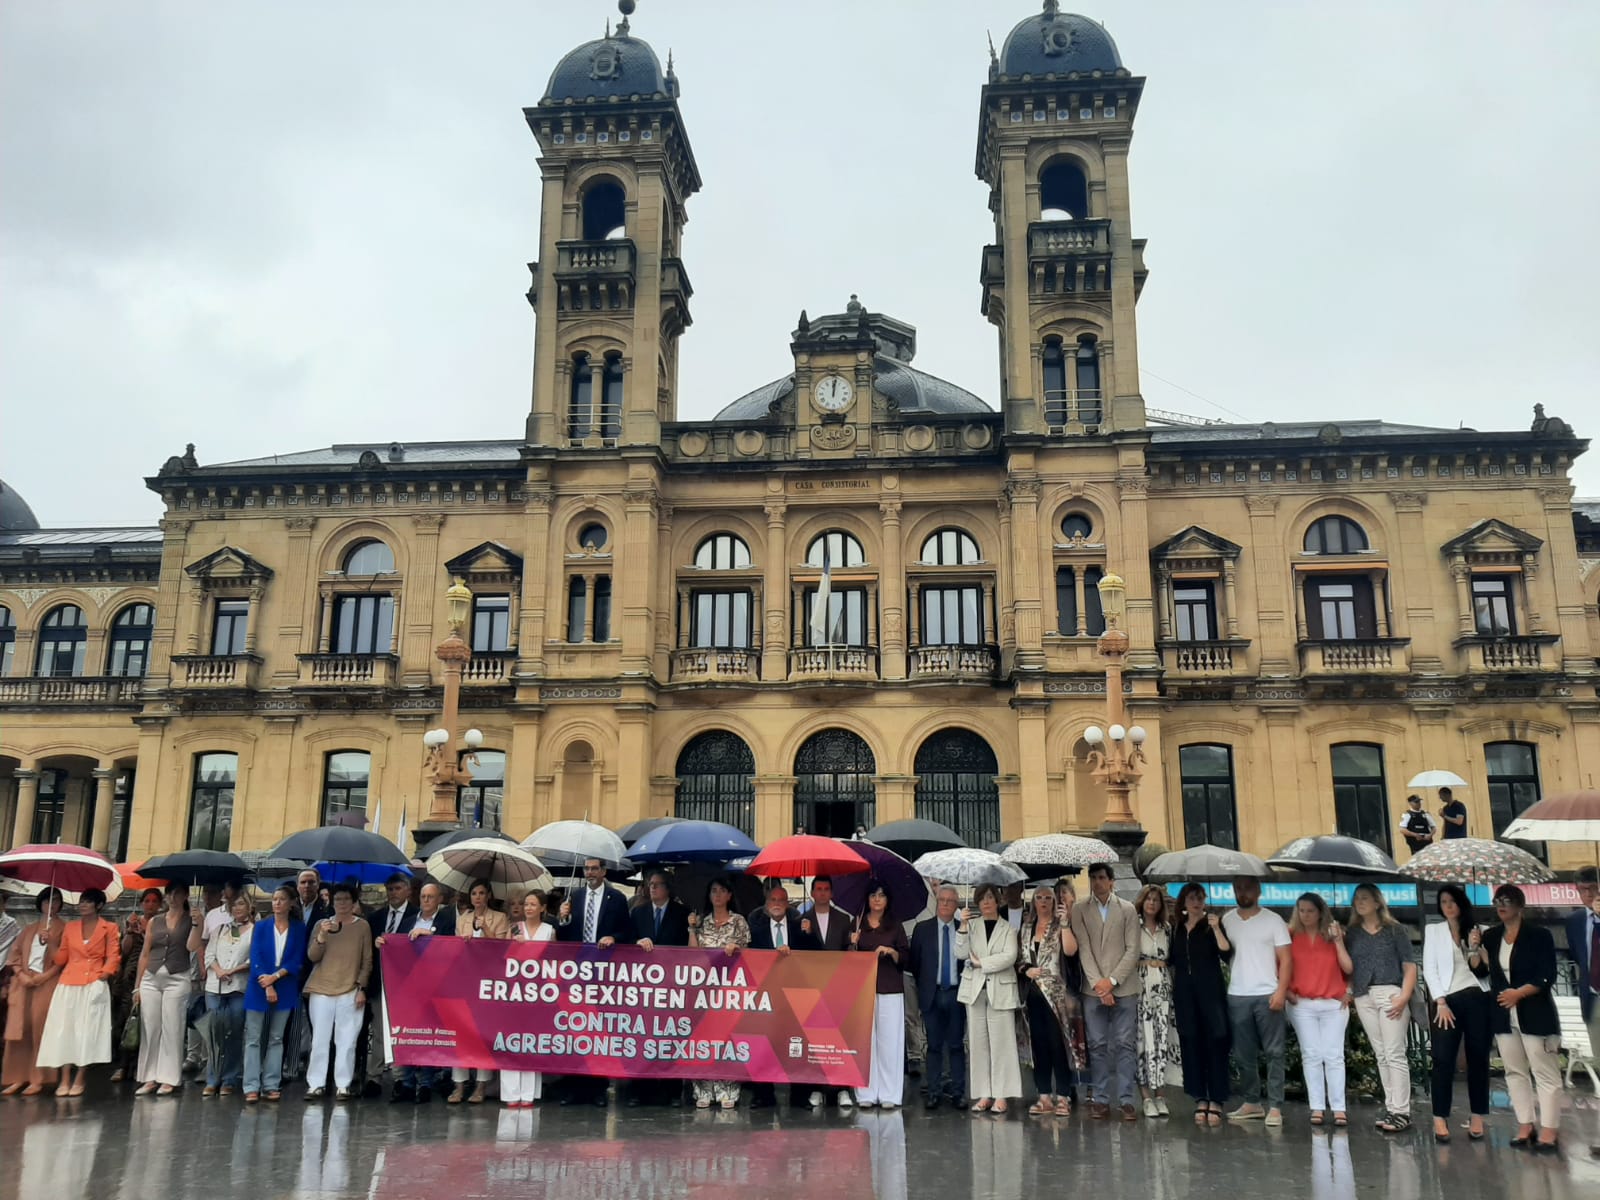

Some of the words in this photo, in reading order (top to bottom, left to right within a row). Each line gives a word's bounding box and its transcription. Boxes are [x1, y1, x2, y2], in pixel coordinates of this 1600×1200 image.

[795, 481, 814, 489] CASA
[821, 480, 871, 489] CONSISTORIAL
[1210, 885, 1236, 899] Ud
[505, 958, 665, 984] DONOSTIAKO
[675, 965, 748, 987] UDALA
[479, 979, 560, 1003] ERASO
[568, 984, 686, 1009] SEXISTEN
[694, 989, 773, 1012] AURKA
[553, 1010, 646, 1035] CONTRA
[653, 1015, 692, 1037] LAS
[493, 1031, 637, 1058] AGRESIONES
[643, 1038, 751, 1062] SEXISTAS
